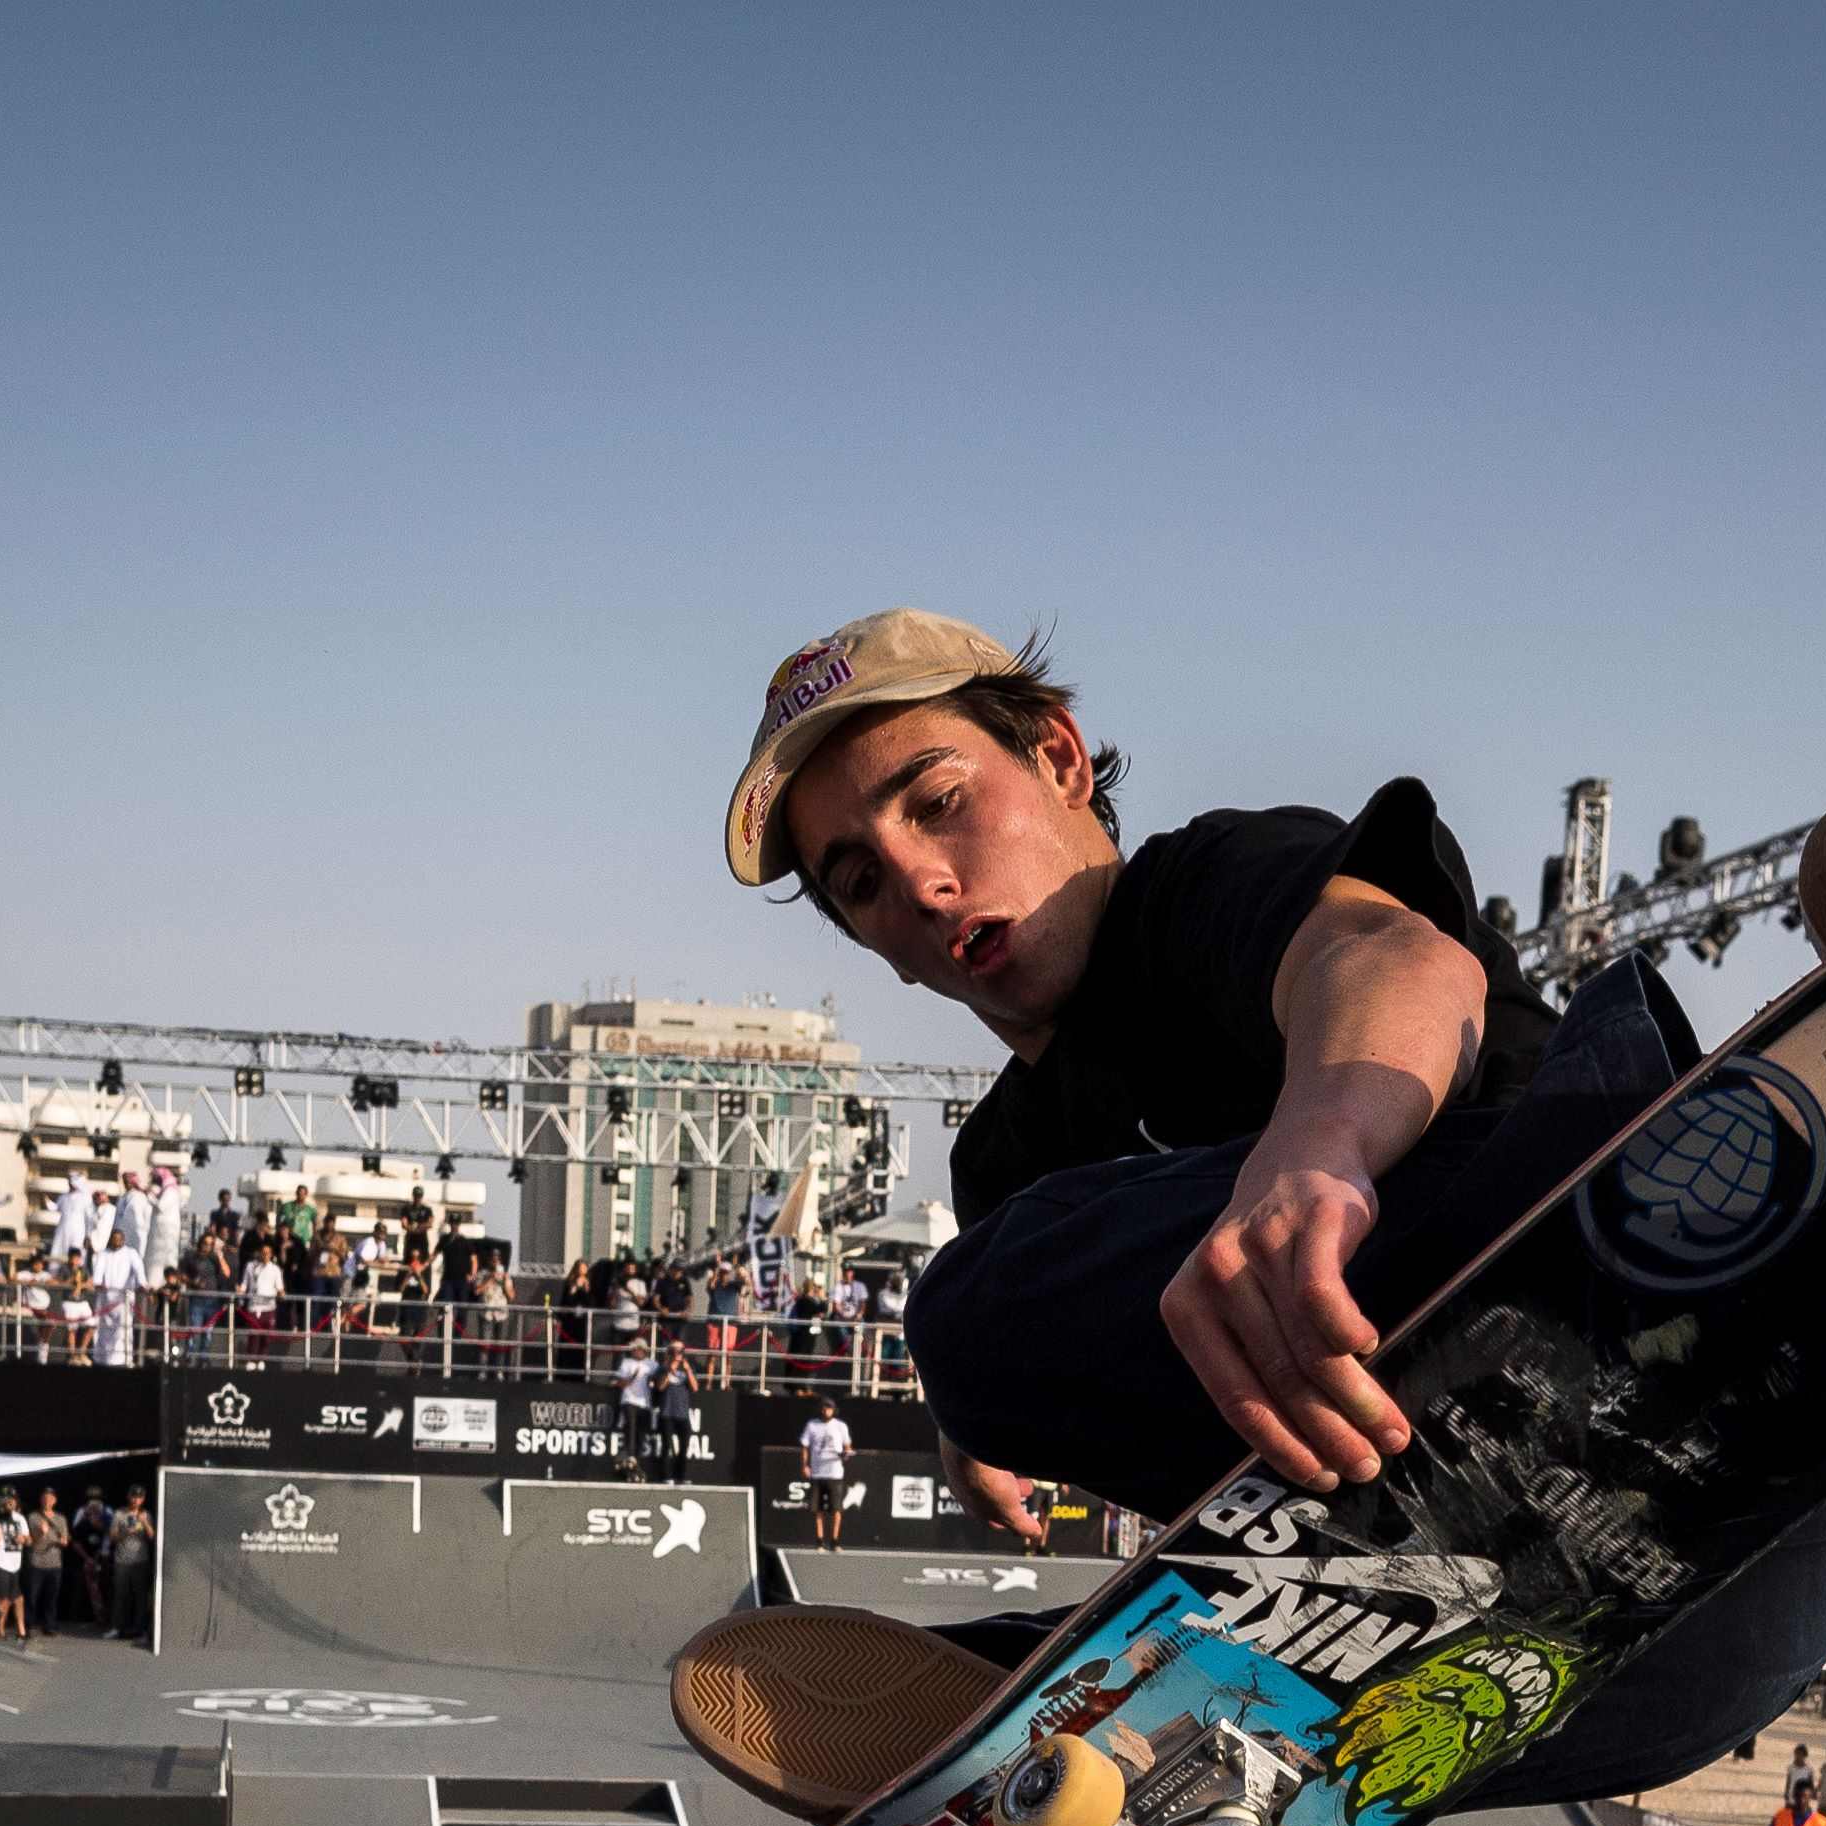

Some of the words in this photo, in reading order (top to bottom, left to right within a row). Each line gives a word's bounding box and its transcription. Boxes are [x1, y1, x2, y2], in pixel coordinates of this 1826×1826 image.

[322, 1406, 367, 1426] STC
[515, 1427, 606, 1456] SPORTS
[587, 1508, 653, 1534] STC
[1198, 1477, 1330, 1555] SB
[922, 1567, 988, 1579] STC
[1180, 1565, 1421, 1684] NIKE
